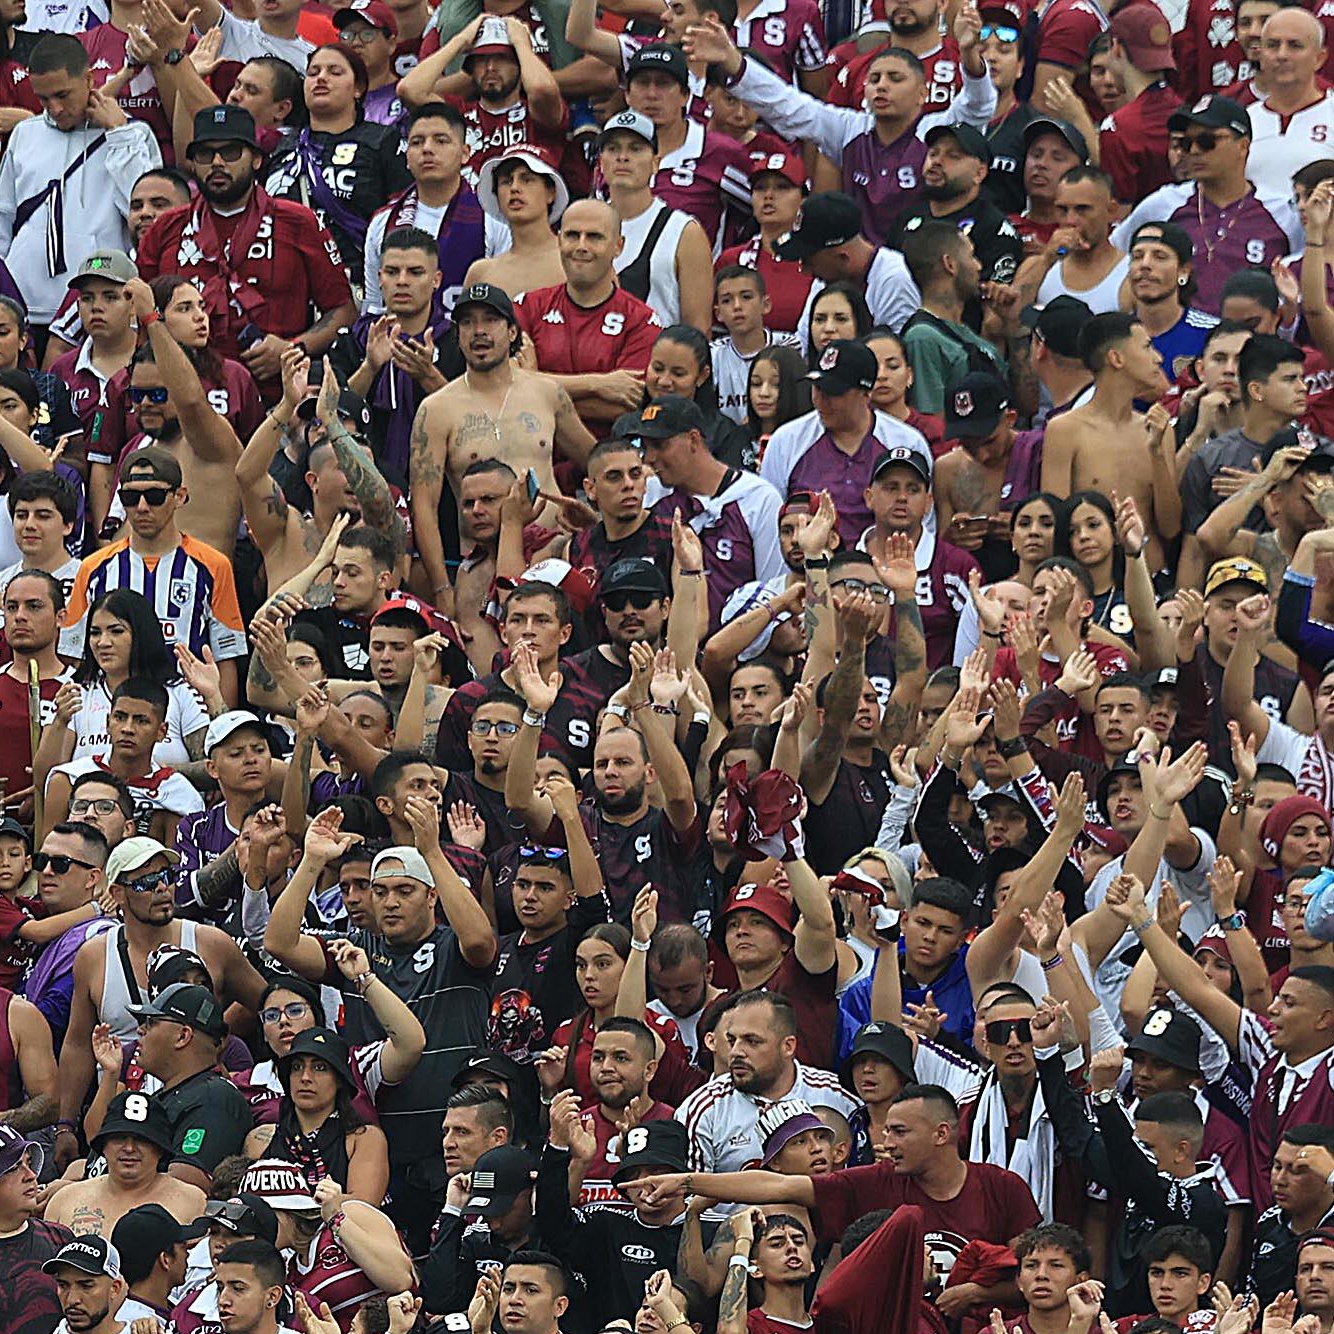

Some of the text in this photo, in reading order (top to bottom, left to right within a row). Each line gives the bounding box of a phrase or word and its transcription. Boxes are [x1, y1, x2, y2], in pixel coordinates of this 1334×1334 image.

[766, 20, 784, 45] S
[935, 61, 954, 83] S
[1309, 125, 1326, 140] S
[335, 144, 357, 164] S
[898, 167, 914, 187] S
[1246, 240, 1263, 262] S
[602, 313, 623, 335] S
[210, 391, 228, 413] S
[718, 539, 731, 559] S
[1110, 603, 1132, 633] S
[570, 720, 589, 748] S
[413, 943, 435, 973] S
[126, 1095, 147, 1120] S
[626, 1128, 647, 1153] S
[245, 1172, 291, 1190] PUERTO
